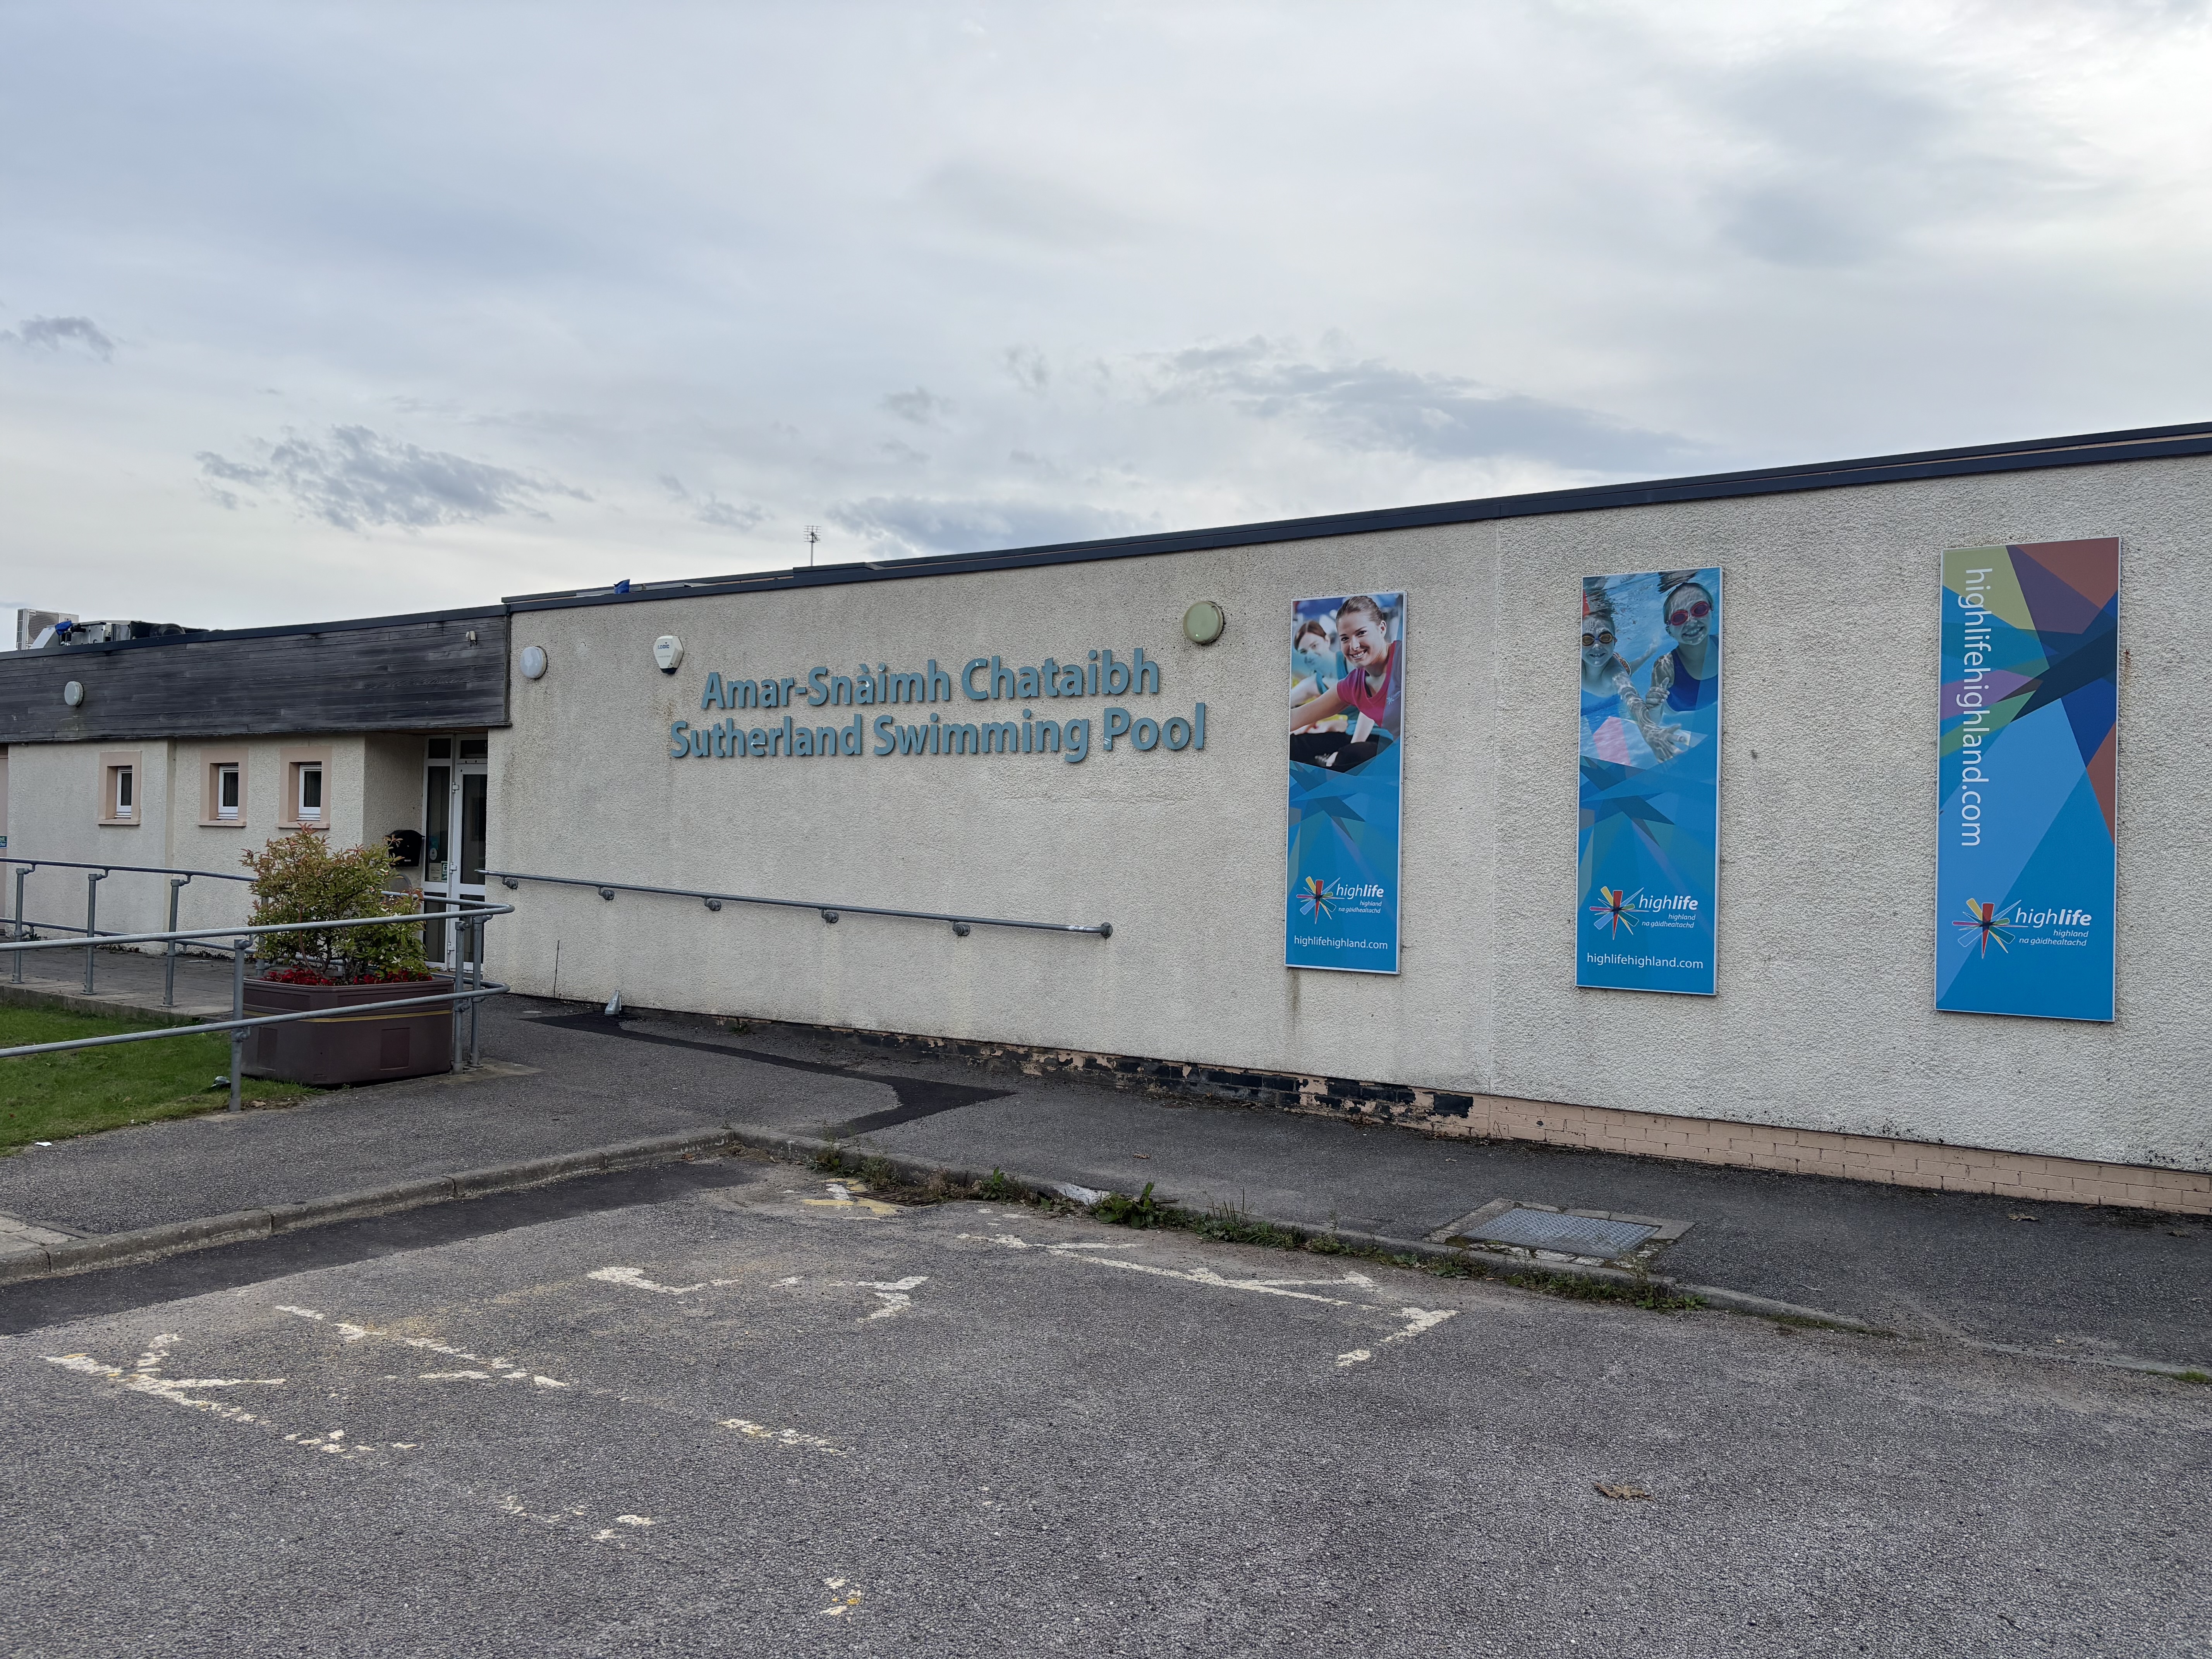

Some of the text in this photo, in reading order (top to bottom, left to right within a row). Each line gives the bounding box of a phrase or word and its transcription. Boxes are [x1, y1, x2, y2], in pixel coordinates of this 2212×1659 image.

[700, 647, 1159, 708] Amar-Snàimh Chataibh
[1956, 568, 1992, 846] highlifehighland.com
[670, 702, 1205, 763] Sutherland Swimming Pool
[1336, 884, 1384, 899] highlife
[1638, 894, 1698, 912] highlife
[2015, 907, 2092, 928] highlife
[1294, 935, 1388, 949] highlifehighland.com
[2030, 938, 2087, 946] gàidhealtachd
[1587, 953, 1704, 969] highlifehighland.com
